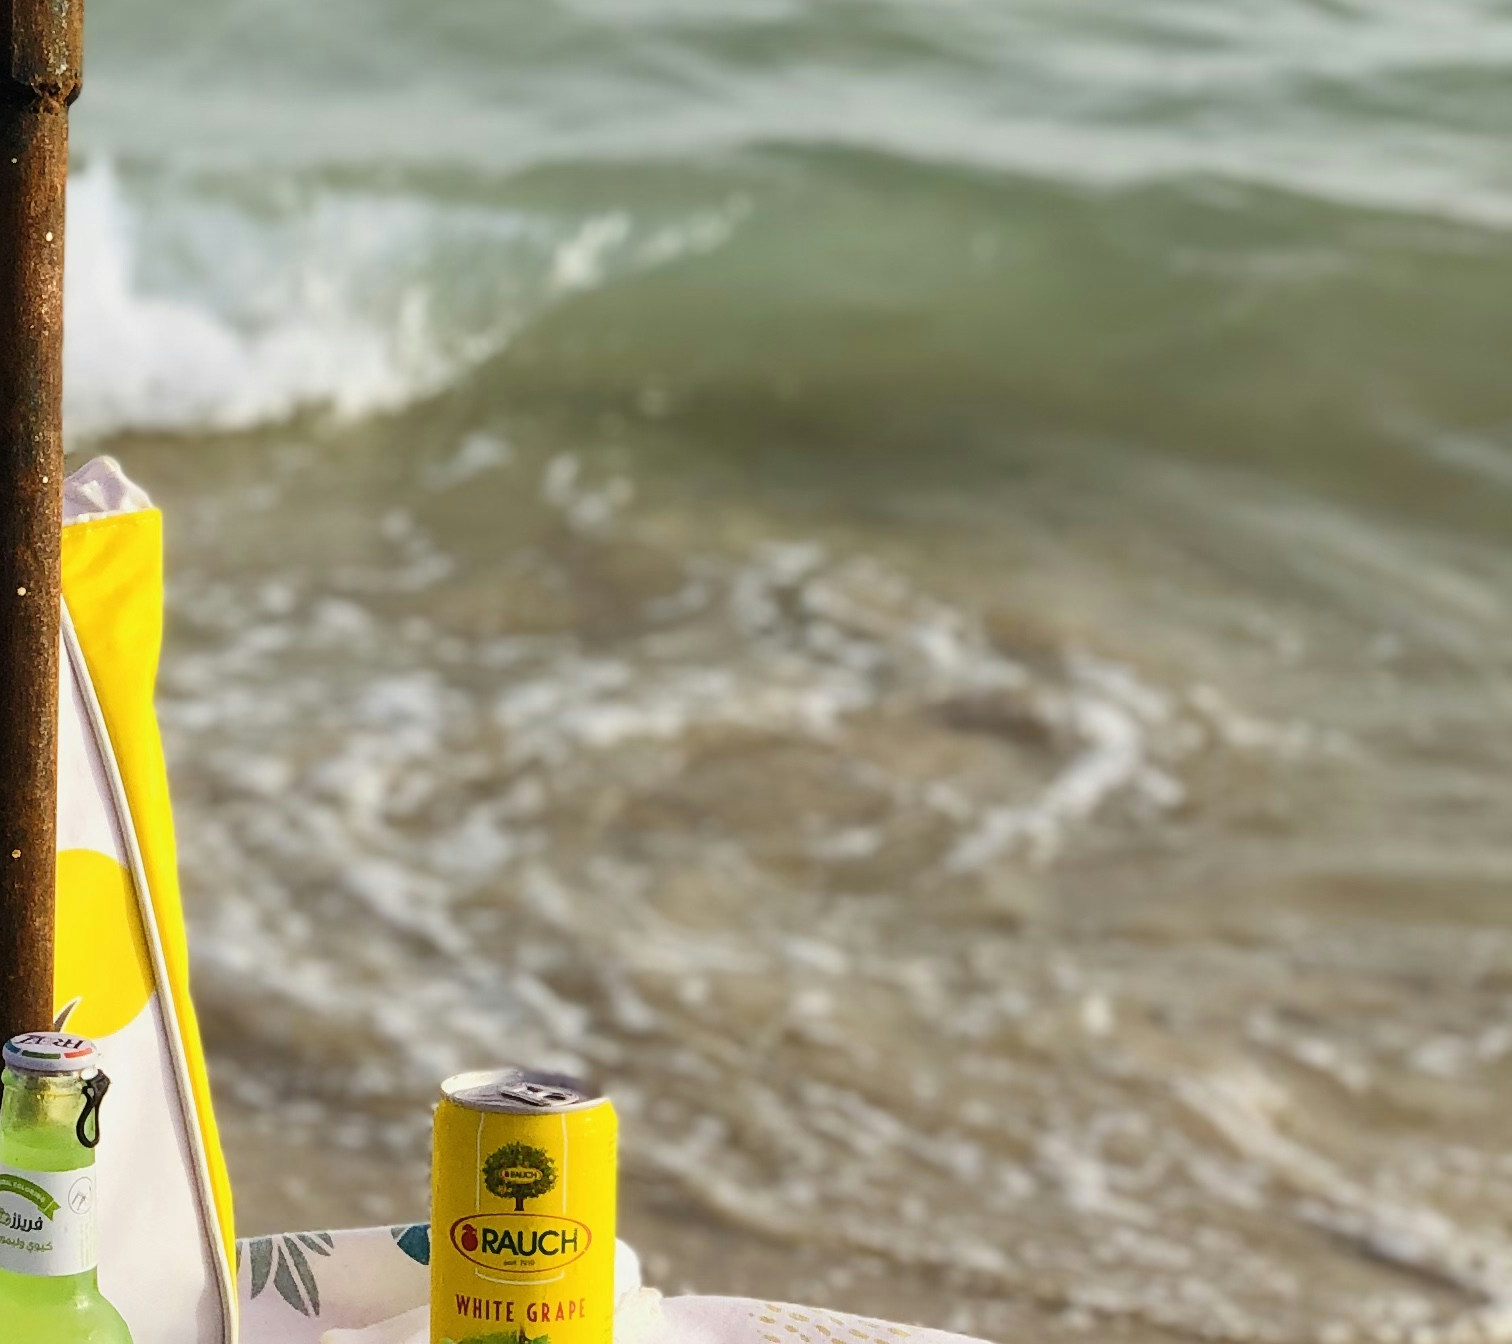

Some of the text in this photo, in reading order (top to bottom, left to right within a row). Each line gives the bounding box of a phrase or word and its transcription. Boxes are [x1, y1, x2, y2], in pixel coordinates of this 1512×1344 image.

[510, 1170, 538, 1179] RAUCH
[481, 1227, 578, 1257] RAUCH
[455, 1294, 586, 1323] WHITE GRAPE
